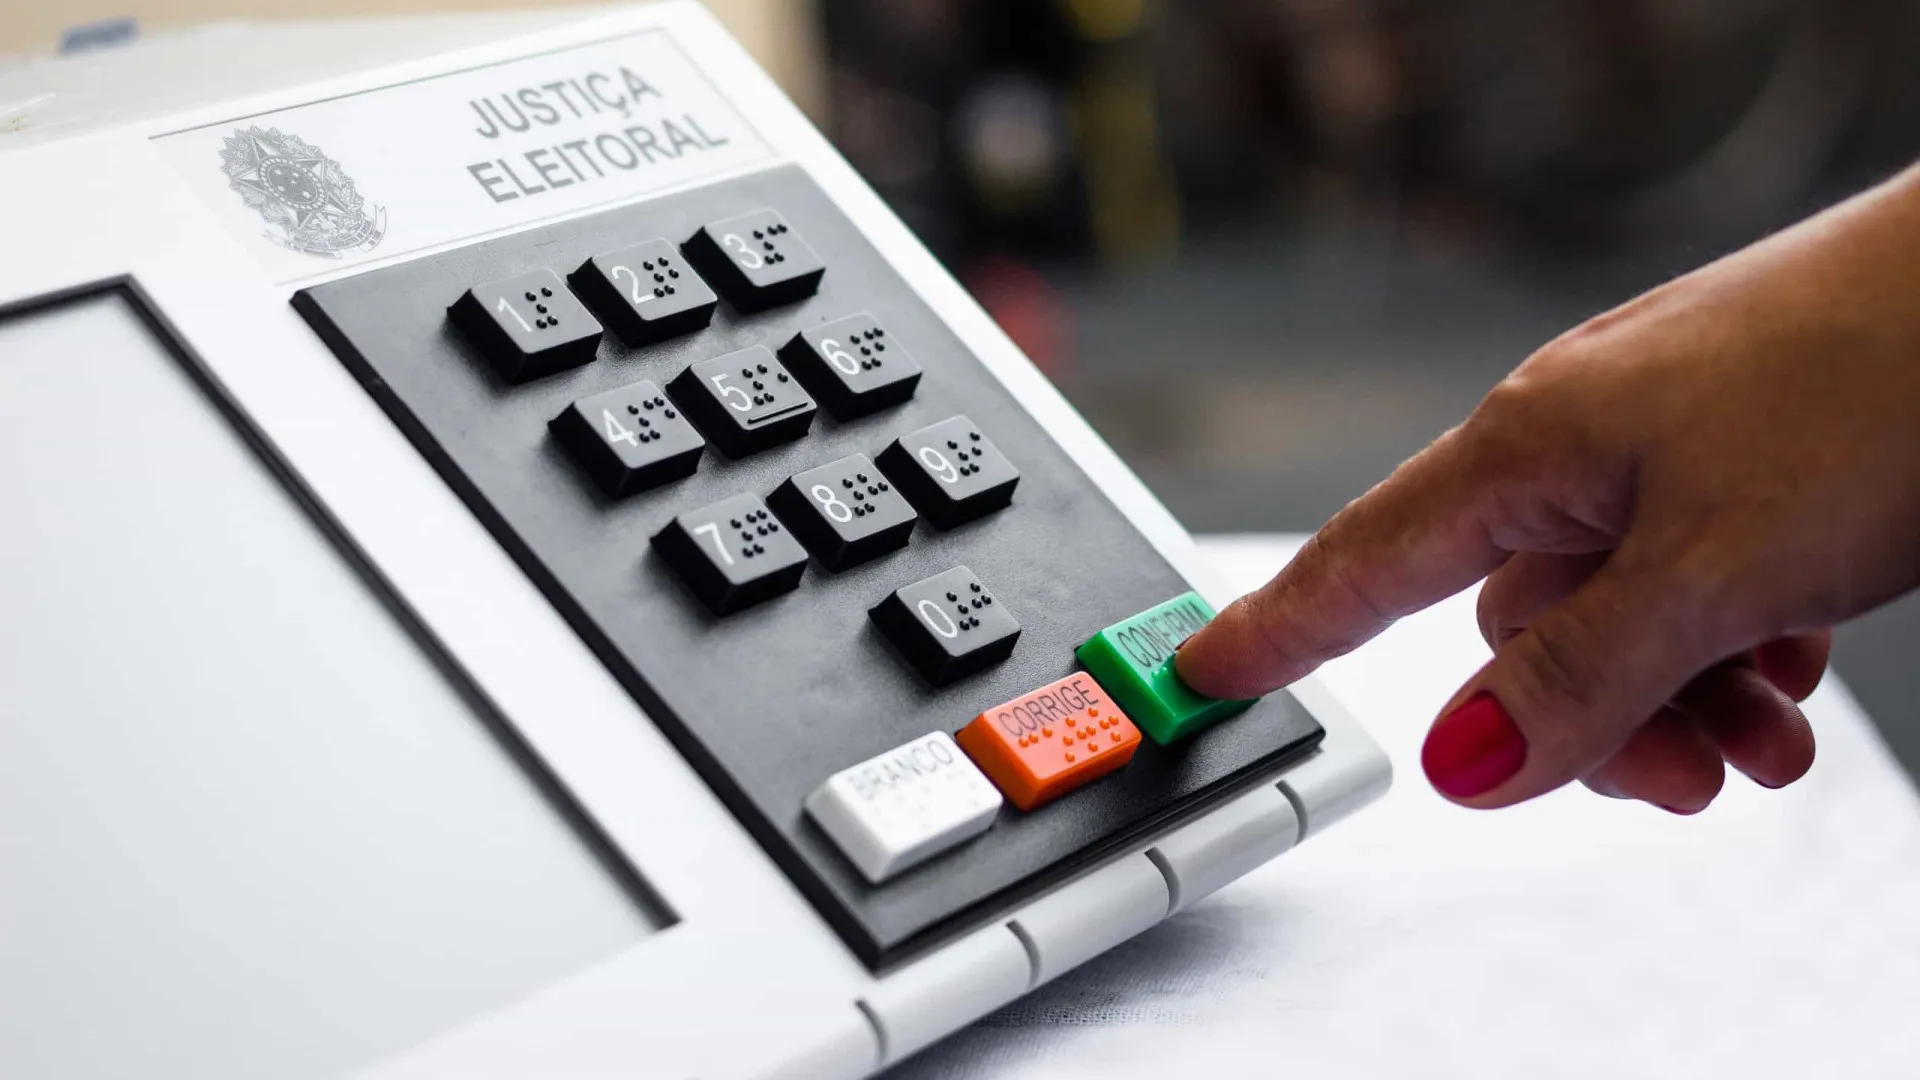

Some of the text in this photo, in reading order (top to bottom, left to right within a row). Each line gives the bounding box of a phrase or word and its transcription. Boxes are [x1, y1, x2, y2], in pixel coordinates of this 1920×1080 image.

[469, 66, 663, 140] JUSTIÇA
[467, 113, 729, 203] ELEITORAL
[724, 232, 764, 269] 3
[611, 265, 655, 304] 2
[497, 296, 532, 332] 1
[820, 338, 860, 376] 6
[712, 373, 753, 412] 5
[602, 409, 638, 449] 4
[918, 446, 958, 484] 9
[811, 484, 853, 523] 8
[694, 522, 735, 566] 7
[918, 599, 958, 639] 0
[998, 679, 1099, 738] CORRIGE
[846, 740, 954, 802] BRANCO
